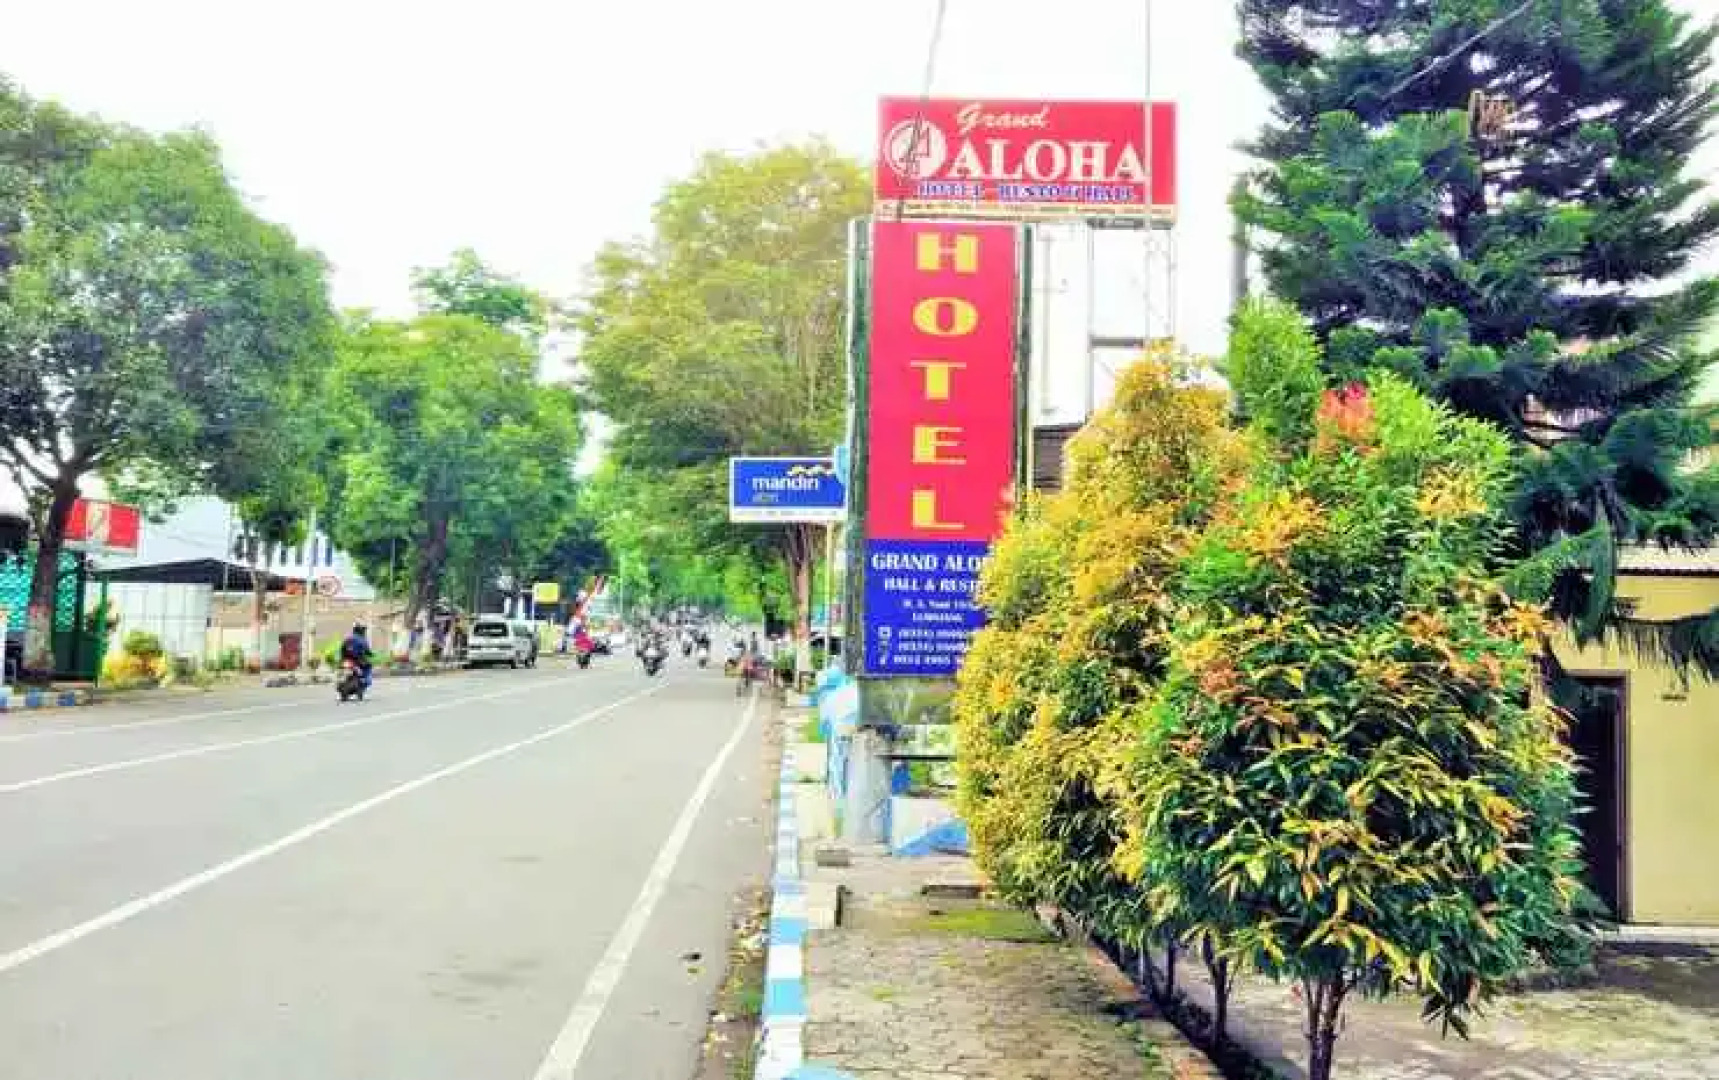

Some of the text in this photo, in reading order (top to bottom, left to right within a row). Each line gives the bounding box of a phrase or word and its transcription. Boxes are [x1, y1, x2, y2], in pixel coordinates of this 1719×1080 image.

[956, 102, 1050, 136] Grand
[946, 138, 1148, 182] ALOHA
[910, 232, 978, 529] HOTEL
[871, 553, 986, 573] GRAND ALO
[884, 577, 921, 592] HALL
[940, 579, 981, 593] REST
